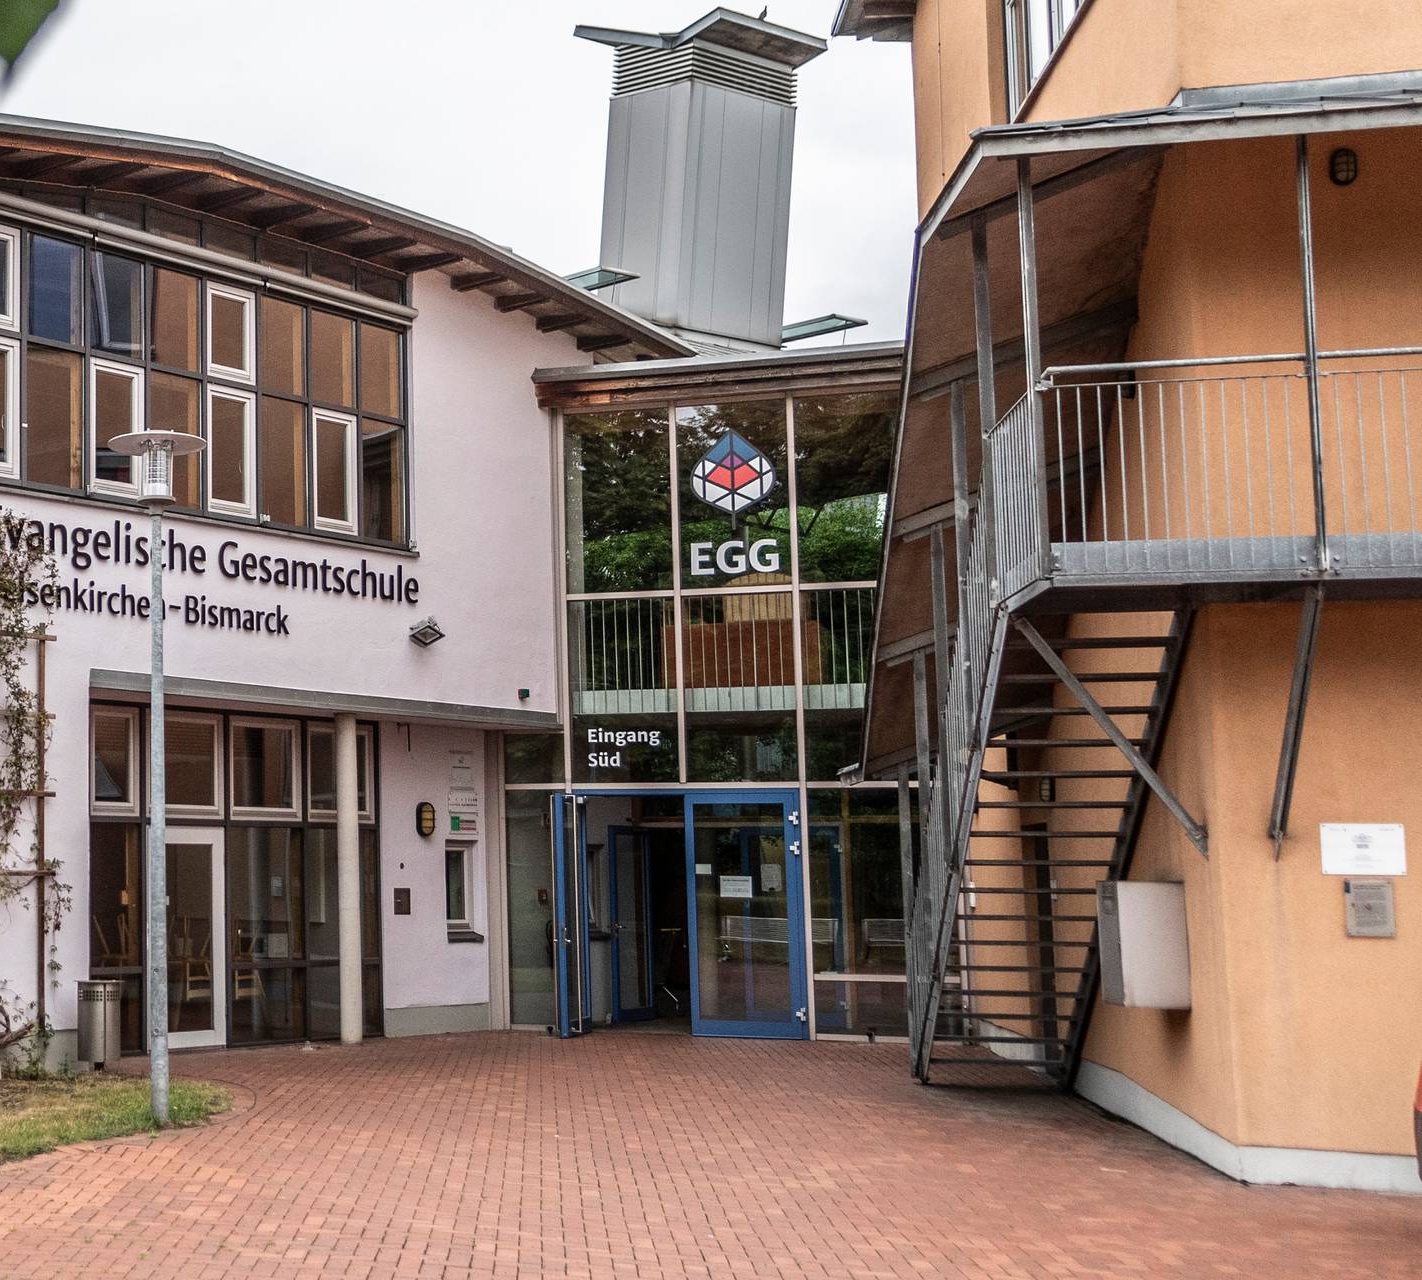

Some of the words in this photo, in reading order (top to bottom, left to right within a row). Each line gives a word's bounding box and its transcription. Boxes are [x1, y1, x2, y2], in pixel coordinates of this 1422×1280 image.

[690, 539, 780, 576] EGG
[217, 541, 420, 604] Gesamtschule
[587, 728, 660, 747] Eingang
[587, 751, 621, 768] Süd
